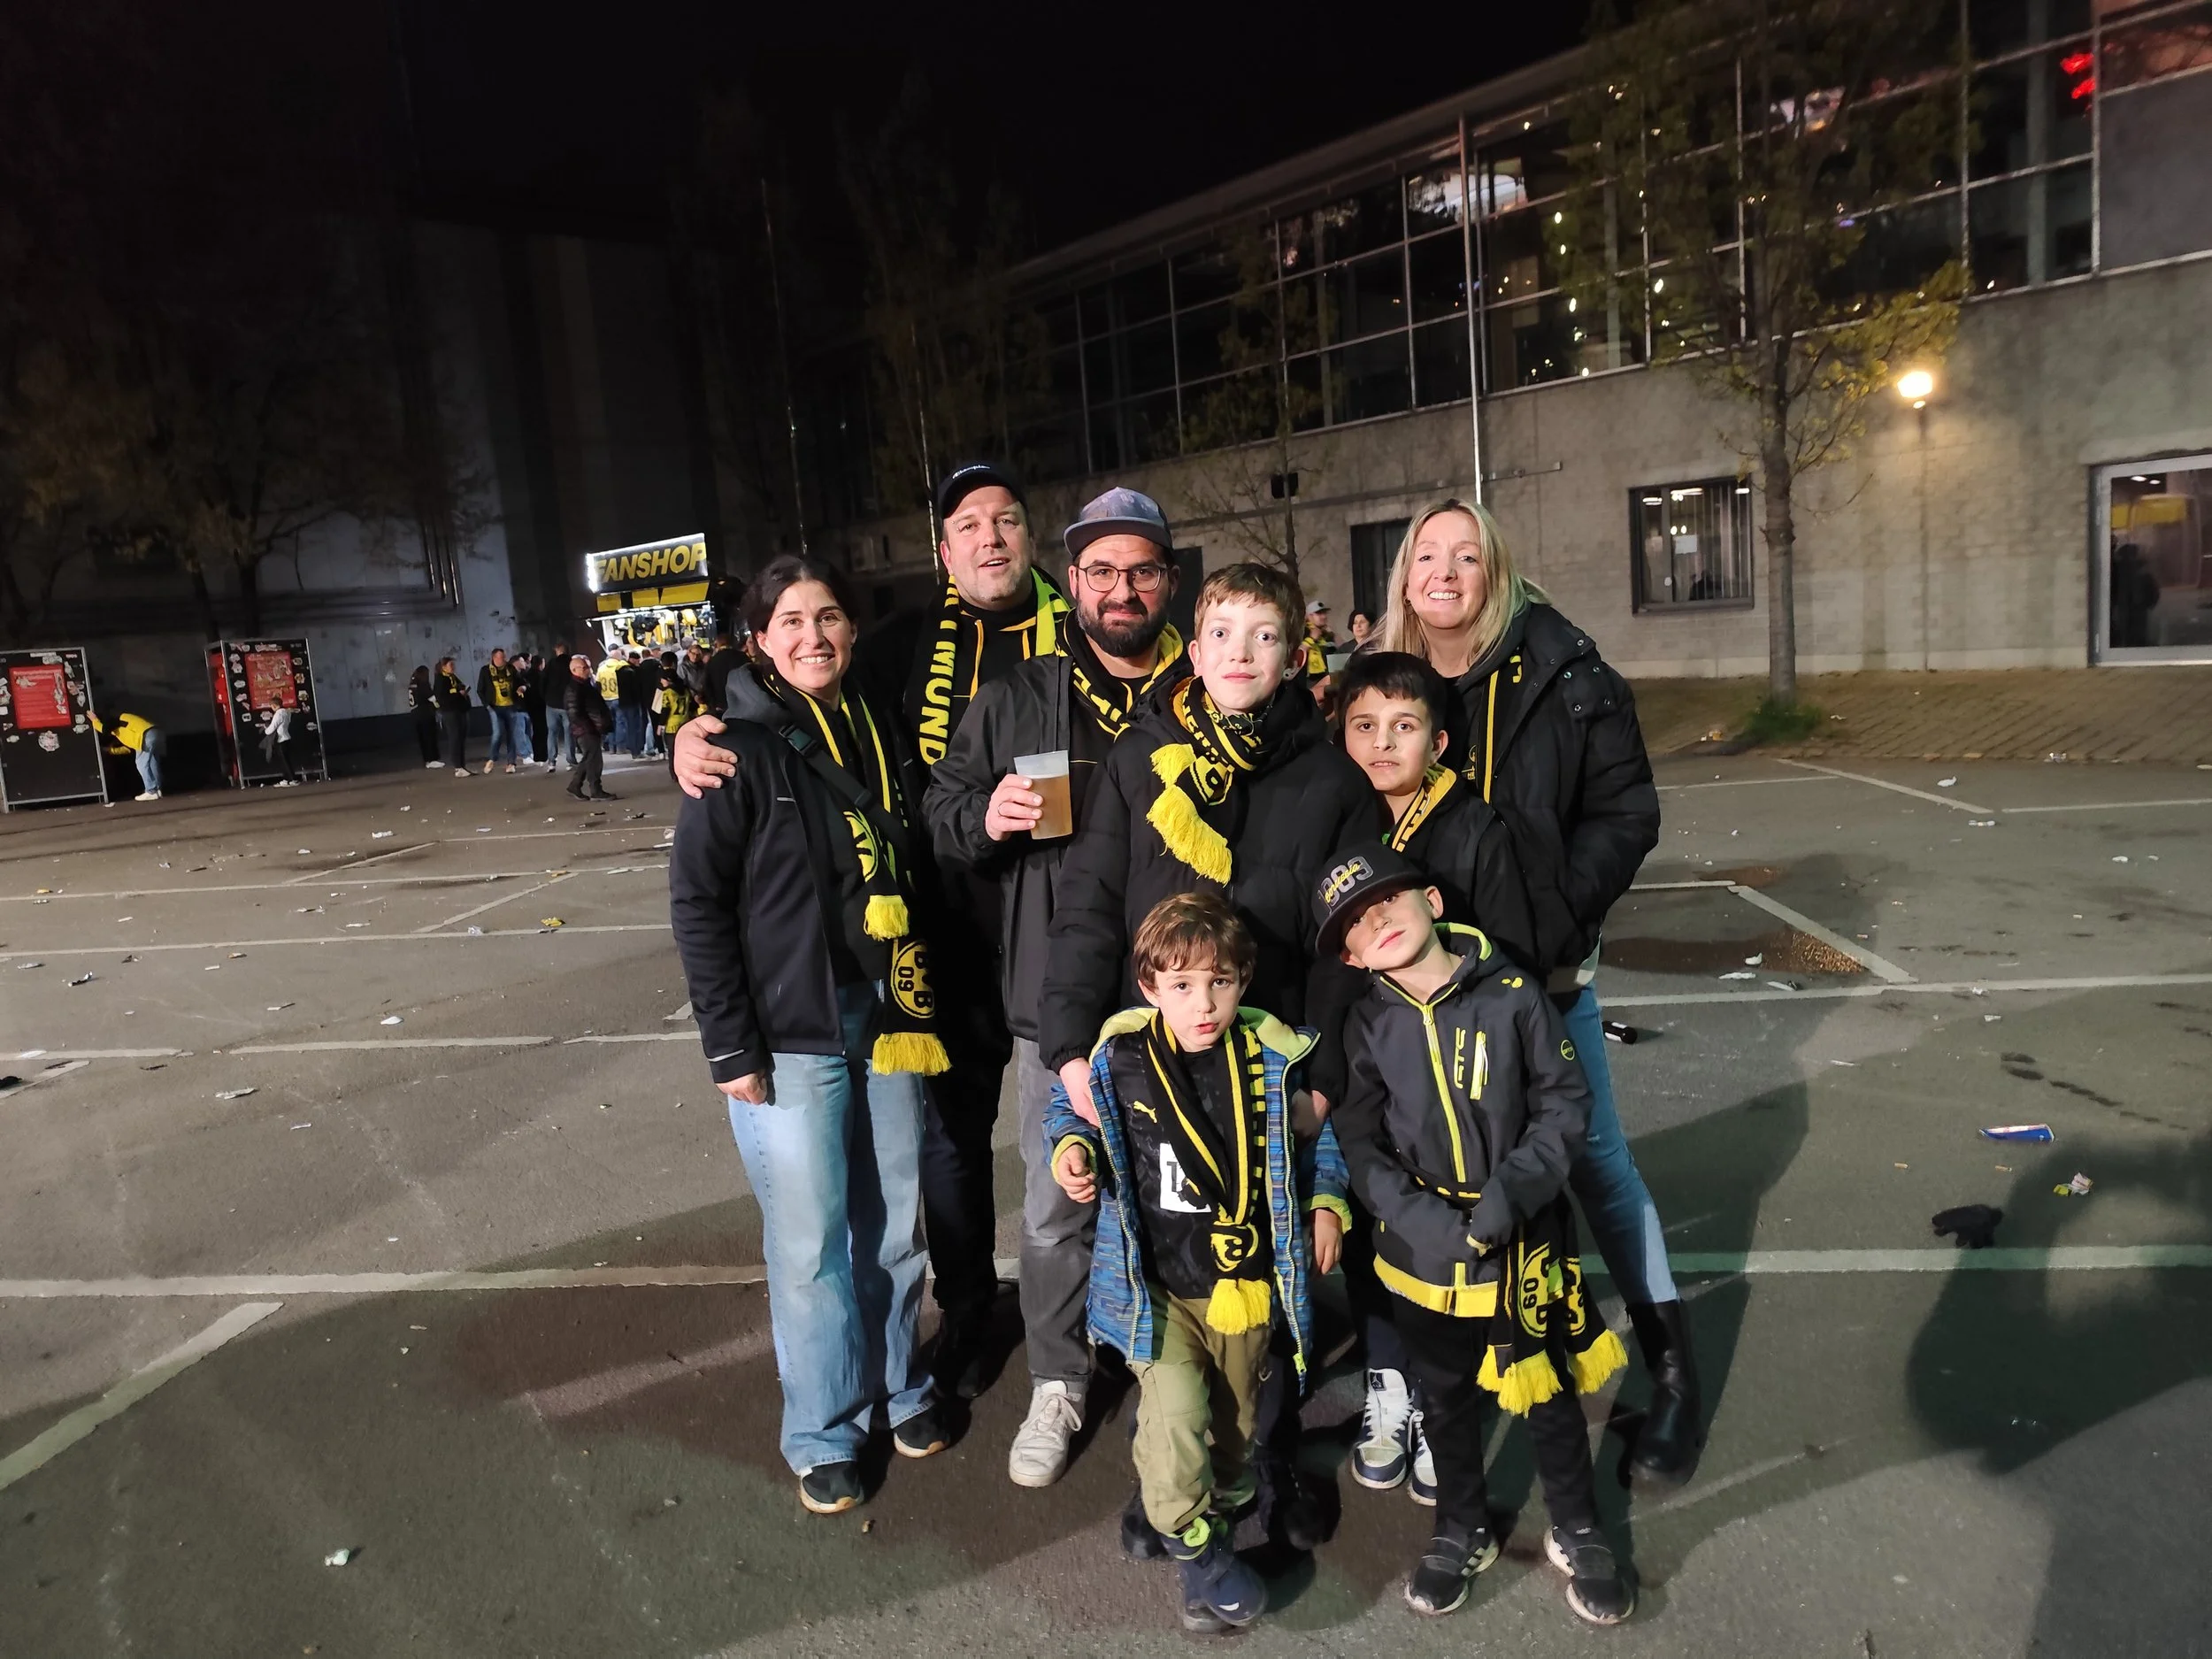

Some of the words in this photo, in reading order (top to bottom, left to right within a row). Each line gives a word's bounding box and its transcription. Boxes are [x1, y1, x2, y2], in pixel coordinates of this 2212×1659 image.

[595, 541, 707, 583] FANSHOP
[897, 965, 915, 992] 09
[1522, 1277, 1540, 1310] 09
